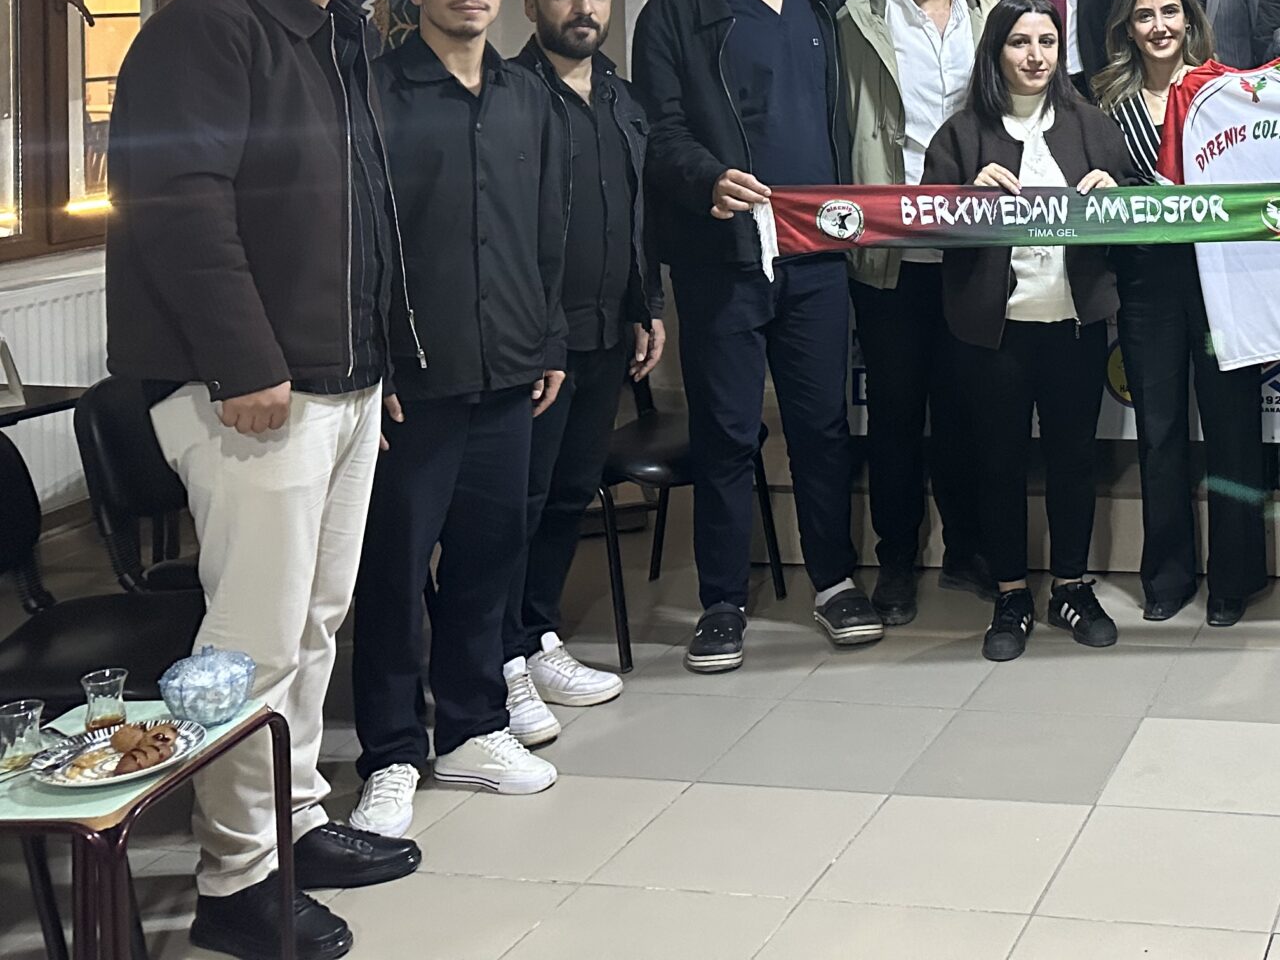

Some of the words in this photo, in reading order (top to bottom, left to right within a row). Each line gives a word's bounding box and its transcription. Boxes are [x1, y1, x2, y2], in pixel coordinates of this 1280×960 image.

[900, 194, 1068, 226] BERXWEDAN
[1085, 194, 1230, 224] AMEDSPOR
[1028, 227, 1054, 237] TİMA
[1056, 229, 1078, 237] GEL
